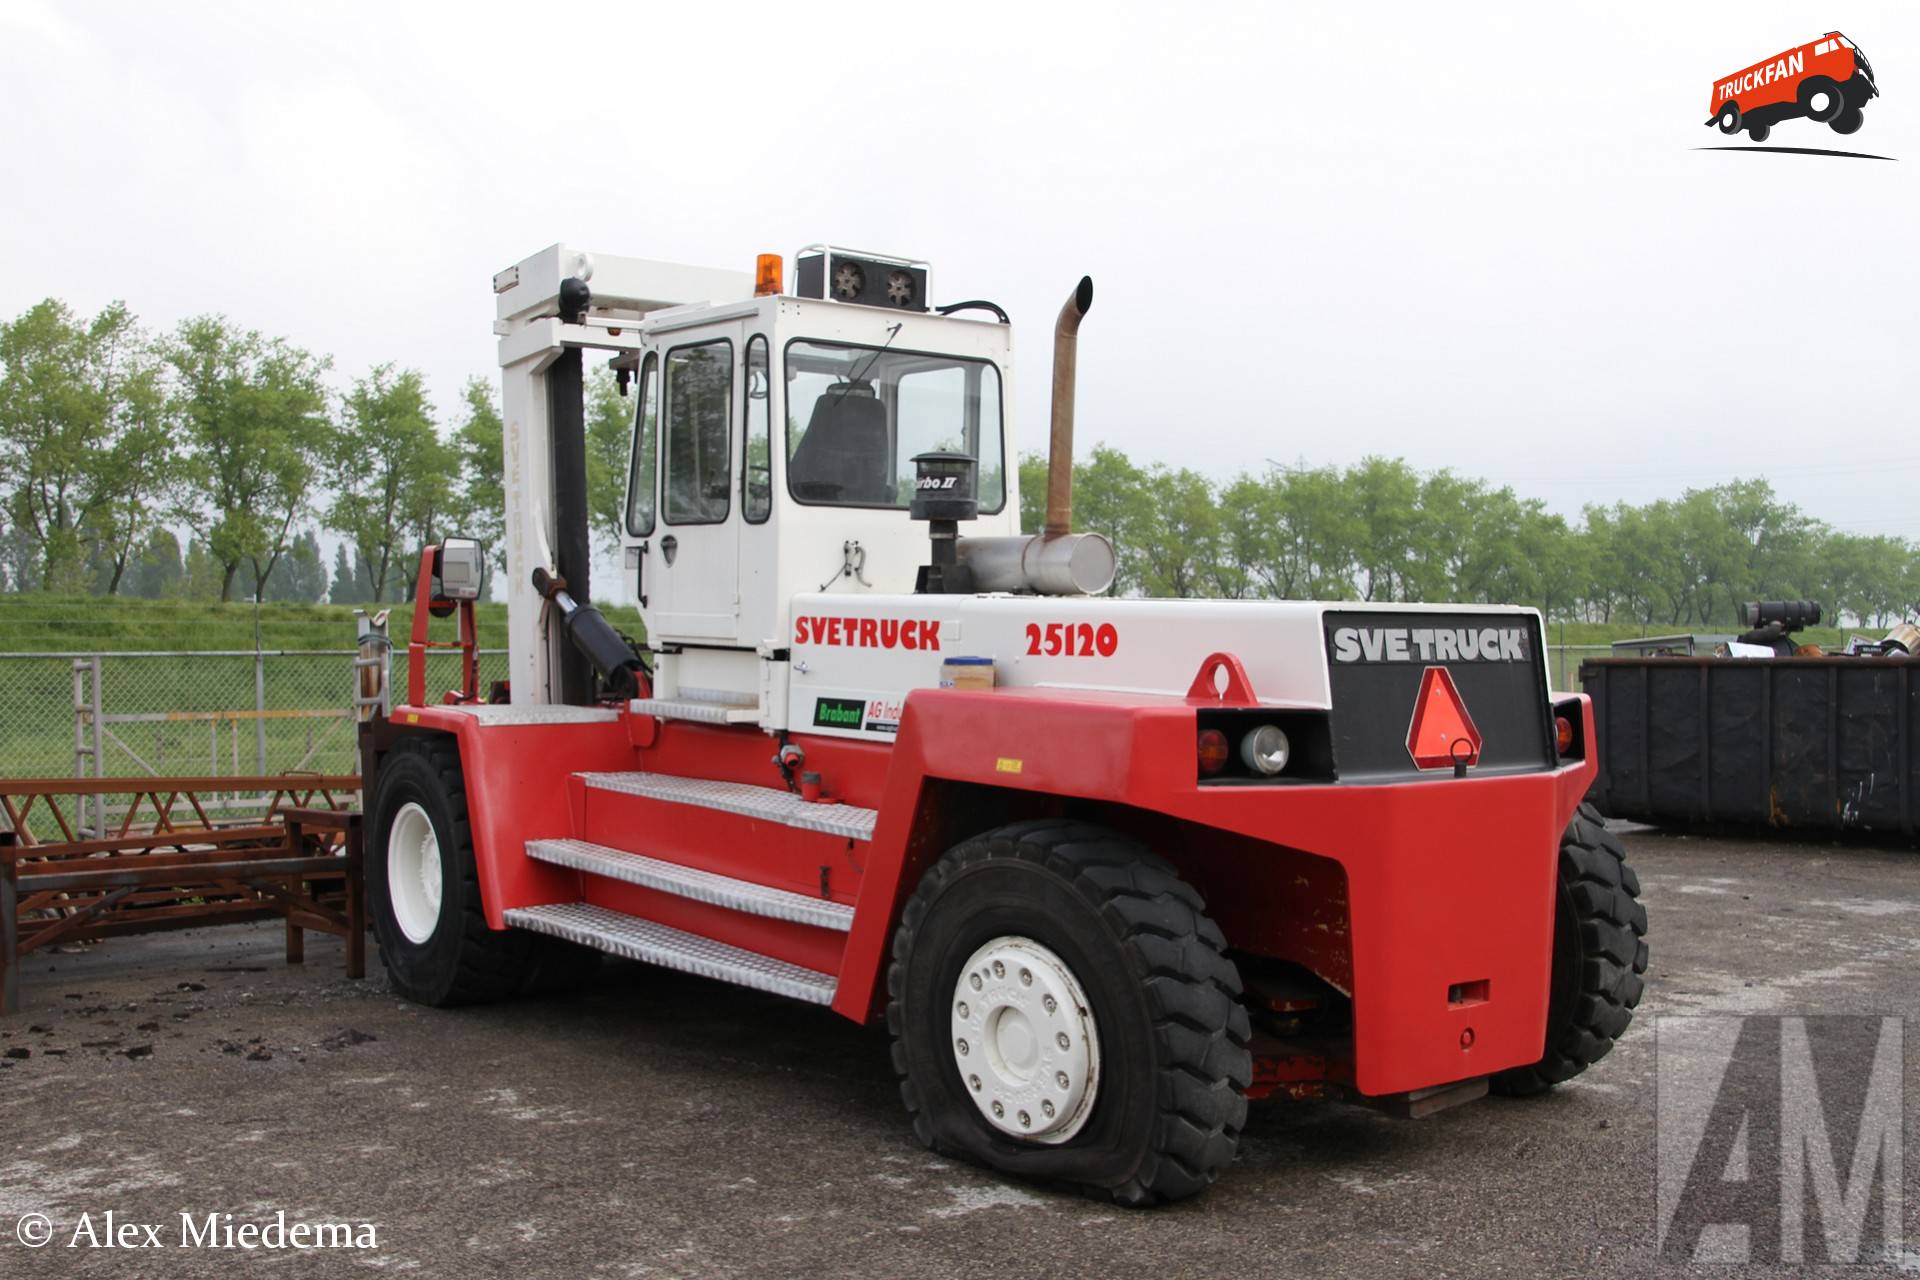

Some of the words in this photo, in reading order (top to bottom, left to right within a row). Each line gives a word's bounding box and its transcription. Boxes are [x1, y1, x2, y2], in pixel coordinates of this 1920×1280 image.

[940, 477, 957, 489] II
[795, 616, 941, 651] SVETRUCK
[1026, 623, 1118, 658] 25120
[819, 703, 860, 723] Brabant
[868, 701, 882, 718] AG
